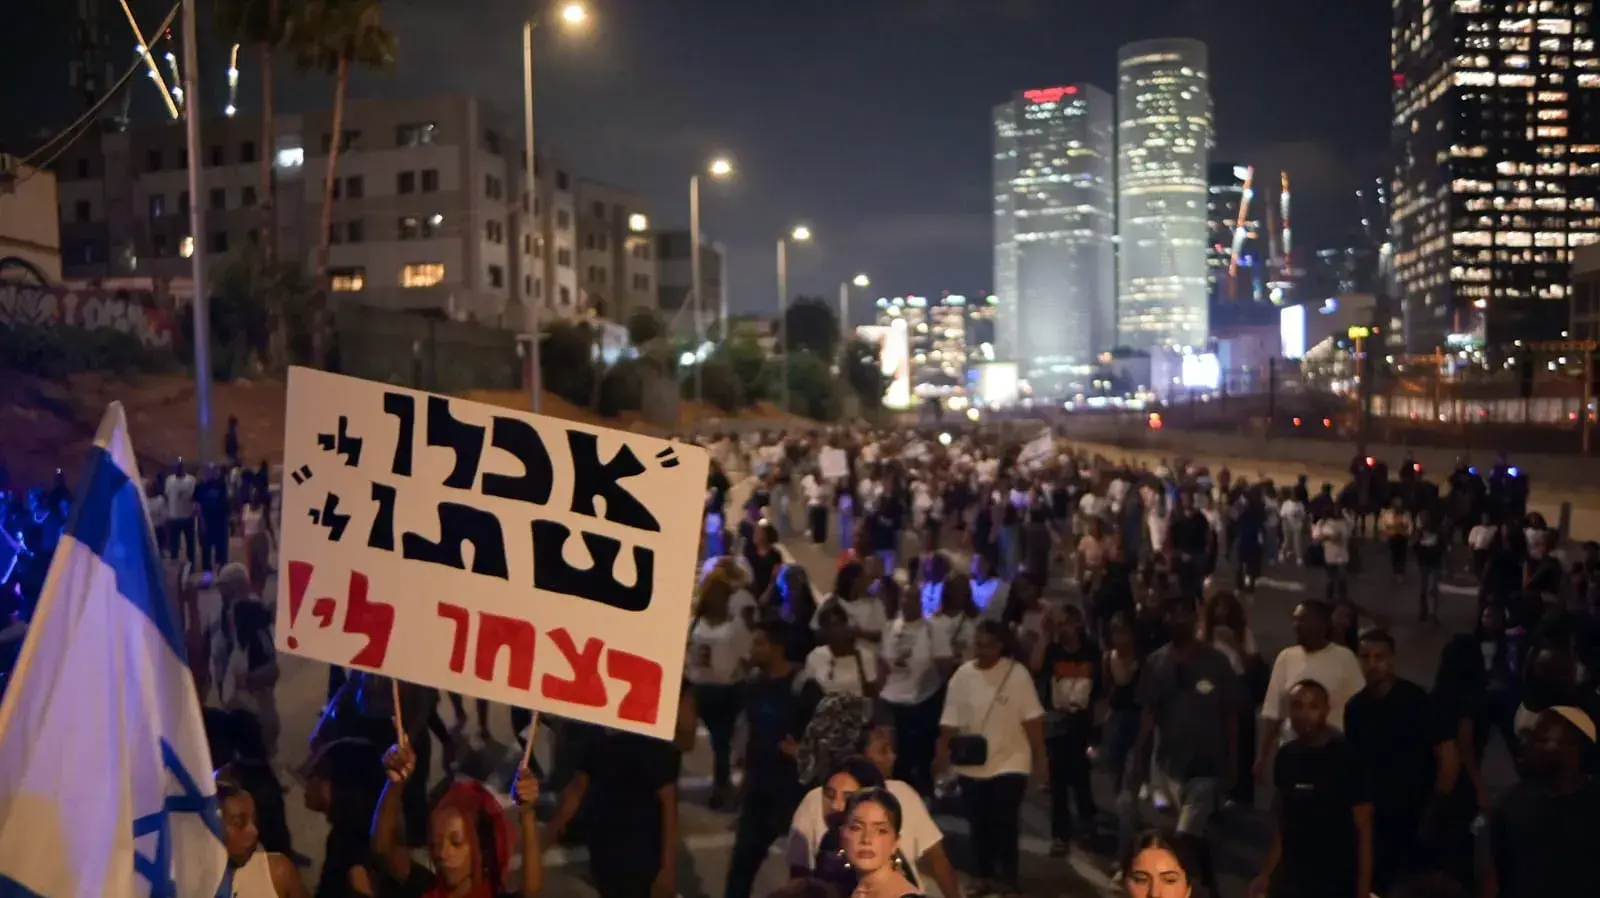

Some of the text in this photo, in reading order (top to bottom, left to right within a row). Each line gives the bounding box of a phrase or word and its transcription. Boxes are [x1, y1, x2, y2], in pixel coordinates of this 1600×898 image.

[317, 415, 363, 468] לי
[368, 481, 655, 612] שתו
[287, 560, 663, 725] רצחו לי!
